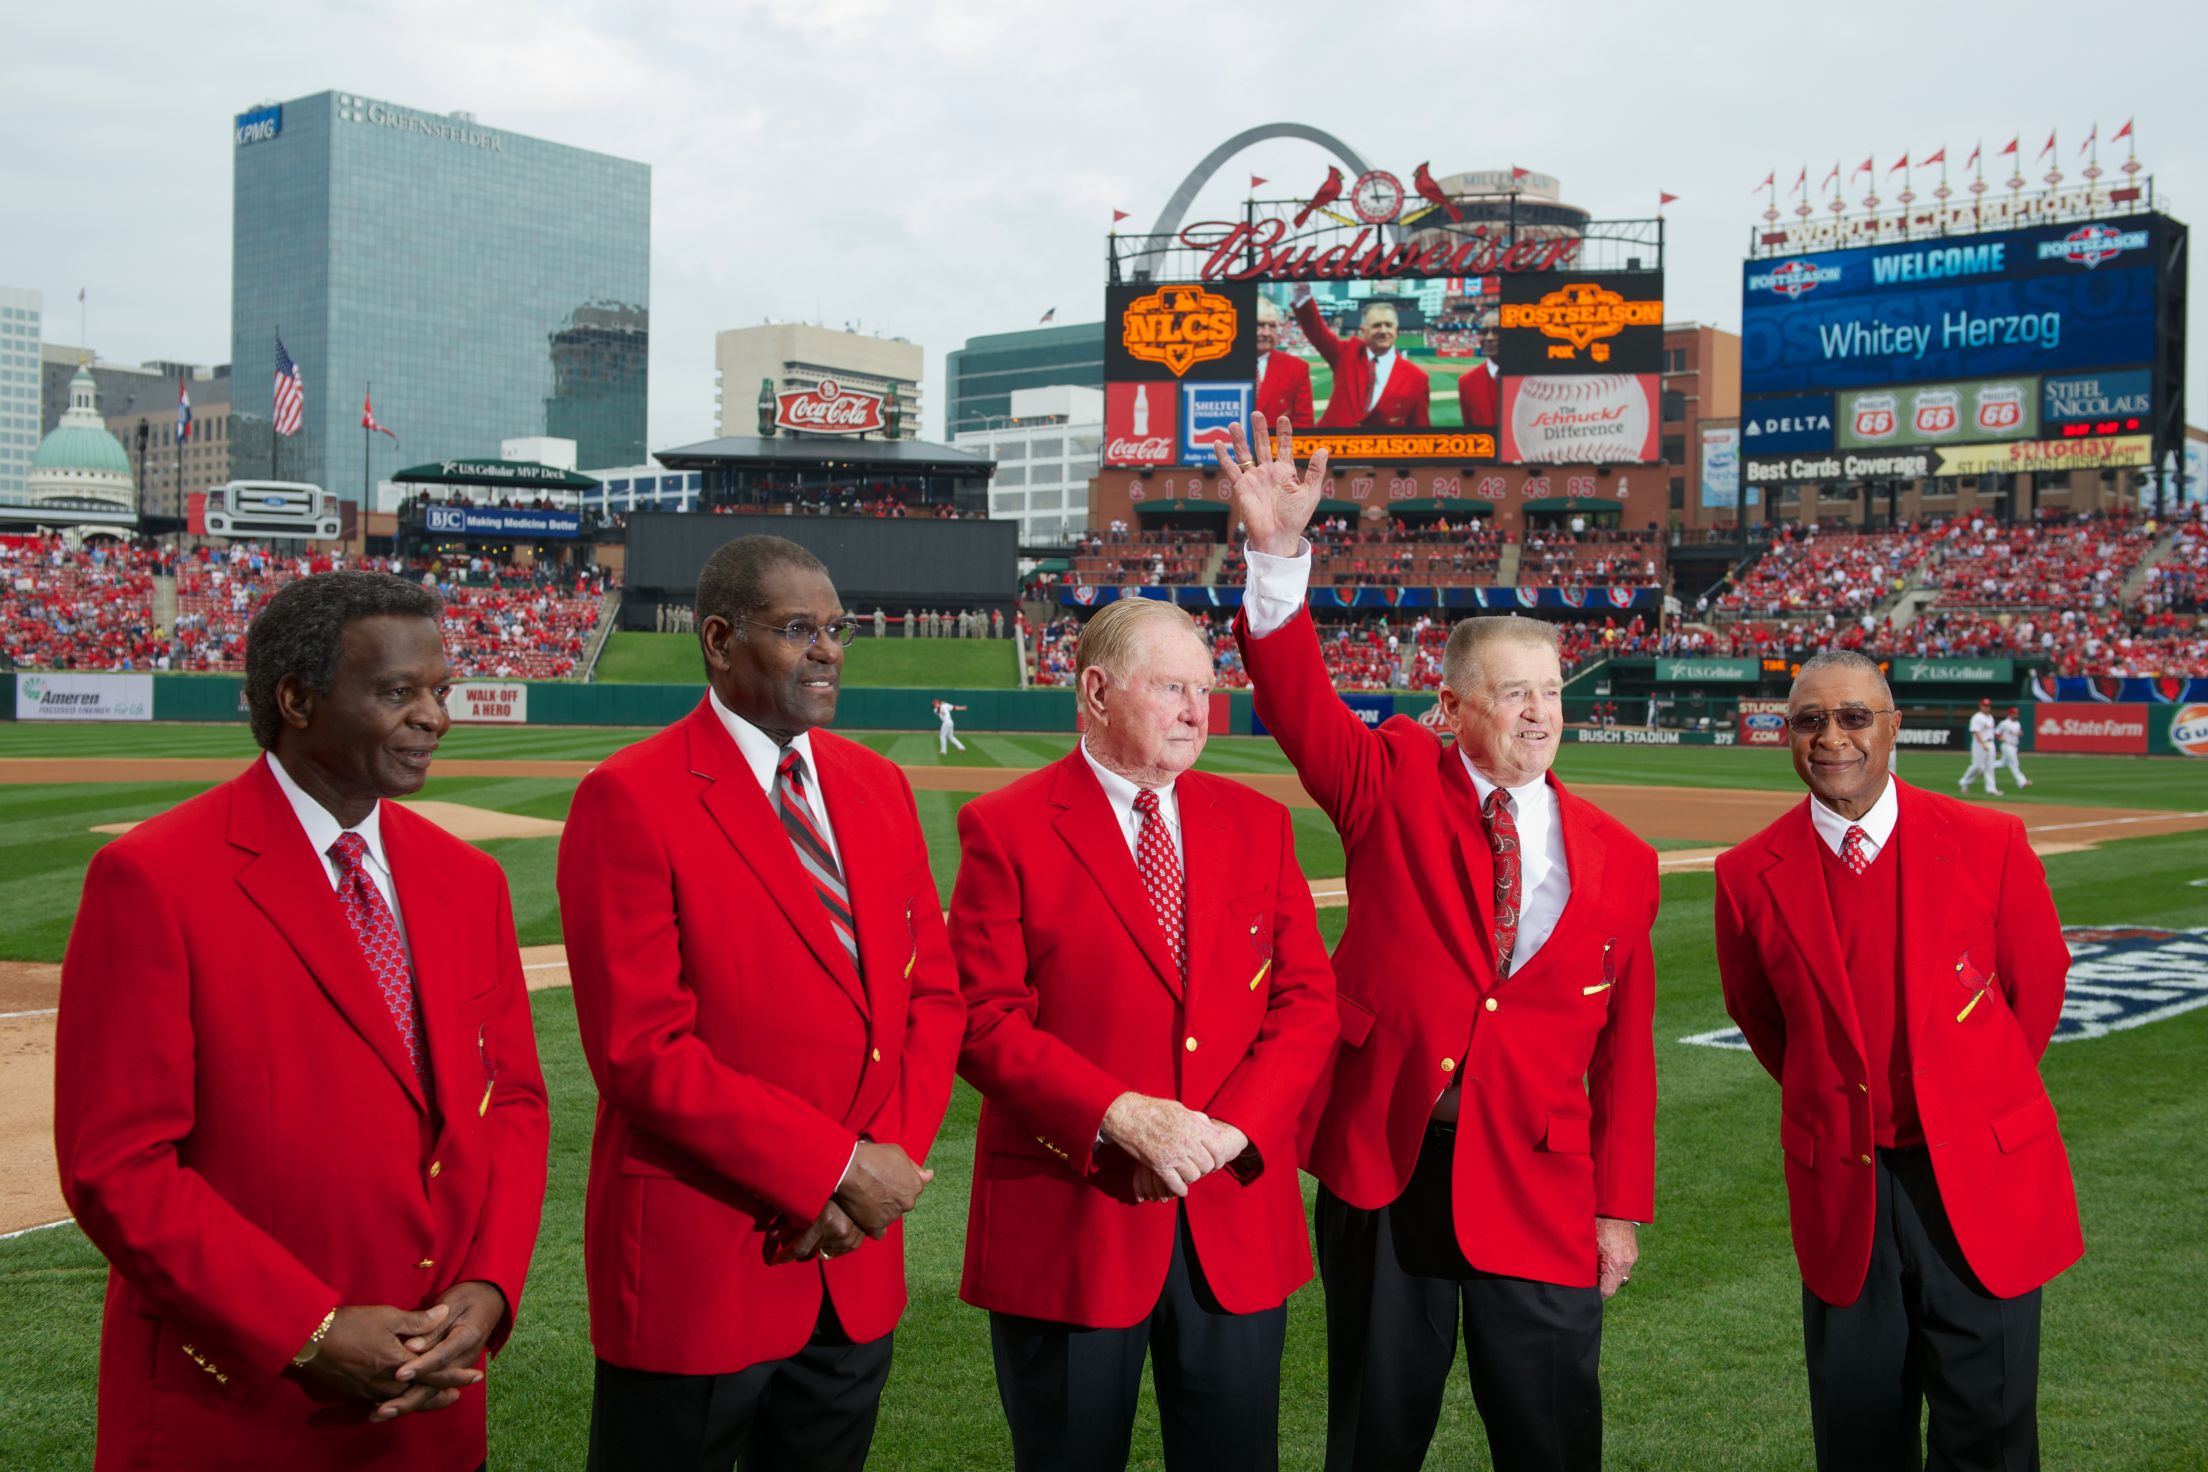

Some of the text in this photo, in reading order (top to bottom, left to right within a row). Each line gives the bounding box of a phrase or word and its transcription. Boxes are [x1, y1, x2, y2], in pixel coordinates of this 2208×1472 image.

[234, 118, 275, 145] KPMG
[367, 103, 501, 151] GREENSFELDER
[1786, 188, 2111, 246] WORLD CHAMPIONS
[1179, 217, 1578, 281] Budweiser
[2038, 231, 2148, 260] POSTSEASON
[1874, 244, 2004, 284] WELCOME
[1749, 267, 1840, 291] POSTSEASON
[1503, 304, 1661, 324] POSTSEASON
[1127, 313, 1233, 342] NLCS
[1820, 310, 2060, 360] Whitey Herzog
[2046, 380, 2102, 399] STIFEL
[1194, 401, 1240, 411] SHELTER
[1194, 410, 1240, 418] INSURANCE
[1529, 404, 1629, 427] Schnucks
[1560, 406, 1576, 415] The
[1982, 405, 2014, 425] 66
[2052, 394, 2149, 418] NICOLAUS
[1766, 415, 1830, 434] DELTA
[1858, 414, 1889, 433] 66
[1918, 411, 1950, 429] 66
[1544, 422, 1624, 440] Difference
[476, 463, 514, 477] Cellular
[517, 466, 539, 478] MVP
[541, 468, 566, 480] Deck
[1747, 453, 1927, 481] Best Cards Coverage
[1165, 479, 1174, 500] 1
[1188, 479, 1202, 500] 2
[1218, 479, 1232, 500] 6
[1352, 478, 1373, 499] 17
[1390, 478, 1417, 499] 20
[1433, 478, 1460, 499] 24
[1478, 477, 1505, 499] 42
[1522, 477, 1550, 498] 45
[1568, 477, 1595, 498] 85
[432, 512, 460, 527] BJC
[467, 516, 577, 531] Making Medicine Better
[1705, 665, 1744, 678] Cellular
[1950, 666, 1994, 679] Cellular
[40, 691, 99, 706] Ameren
[466, 689, 518, 702] WALK-OFF
[472, 704, 511, 717] A HERO
[1751, 716, 1777, 728] Ford
[1579, 729, 1679, 744] BUSCH STADIUM
